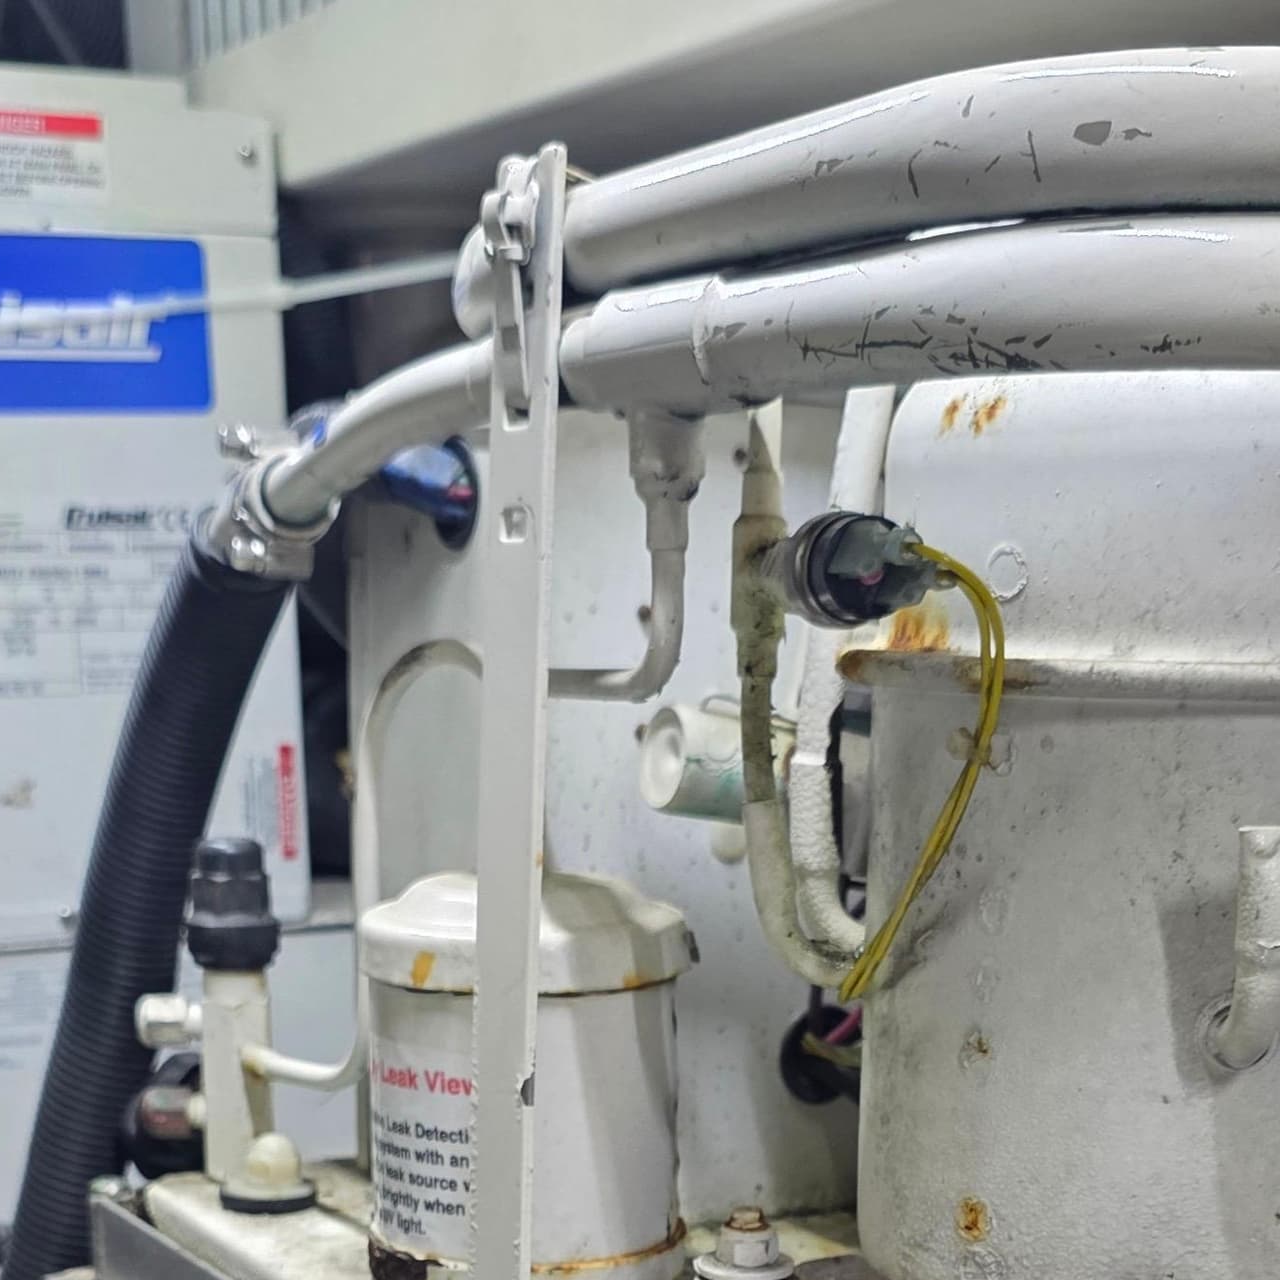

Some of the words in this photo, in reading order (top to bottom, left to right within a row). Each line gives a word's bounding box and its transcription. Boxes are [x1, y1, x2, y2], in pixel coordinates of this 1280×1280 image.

[381, 1062, 419, 1090] Leak
[387, 1116, 411, 1136] Leak
[415, 1123, 469, 1144] Detecti
[415, 1149, 444, 1166] with
[386, 1165, 405, 1181] leak
[409, 1173, 457, 1191] source
[382, 1185, 419, 1213] brightly
[424, 1200, 465, 1216] when
[397, 1213, 426, 1235] light.
